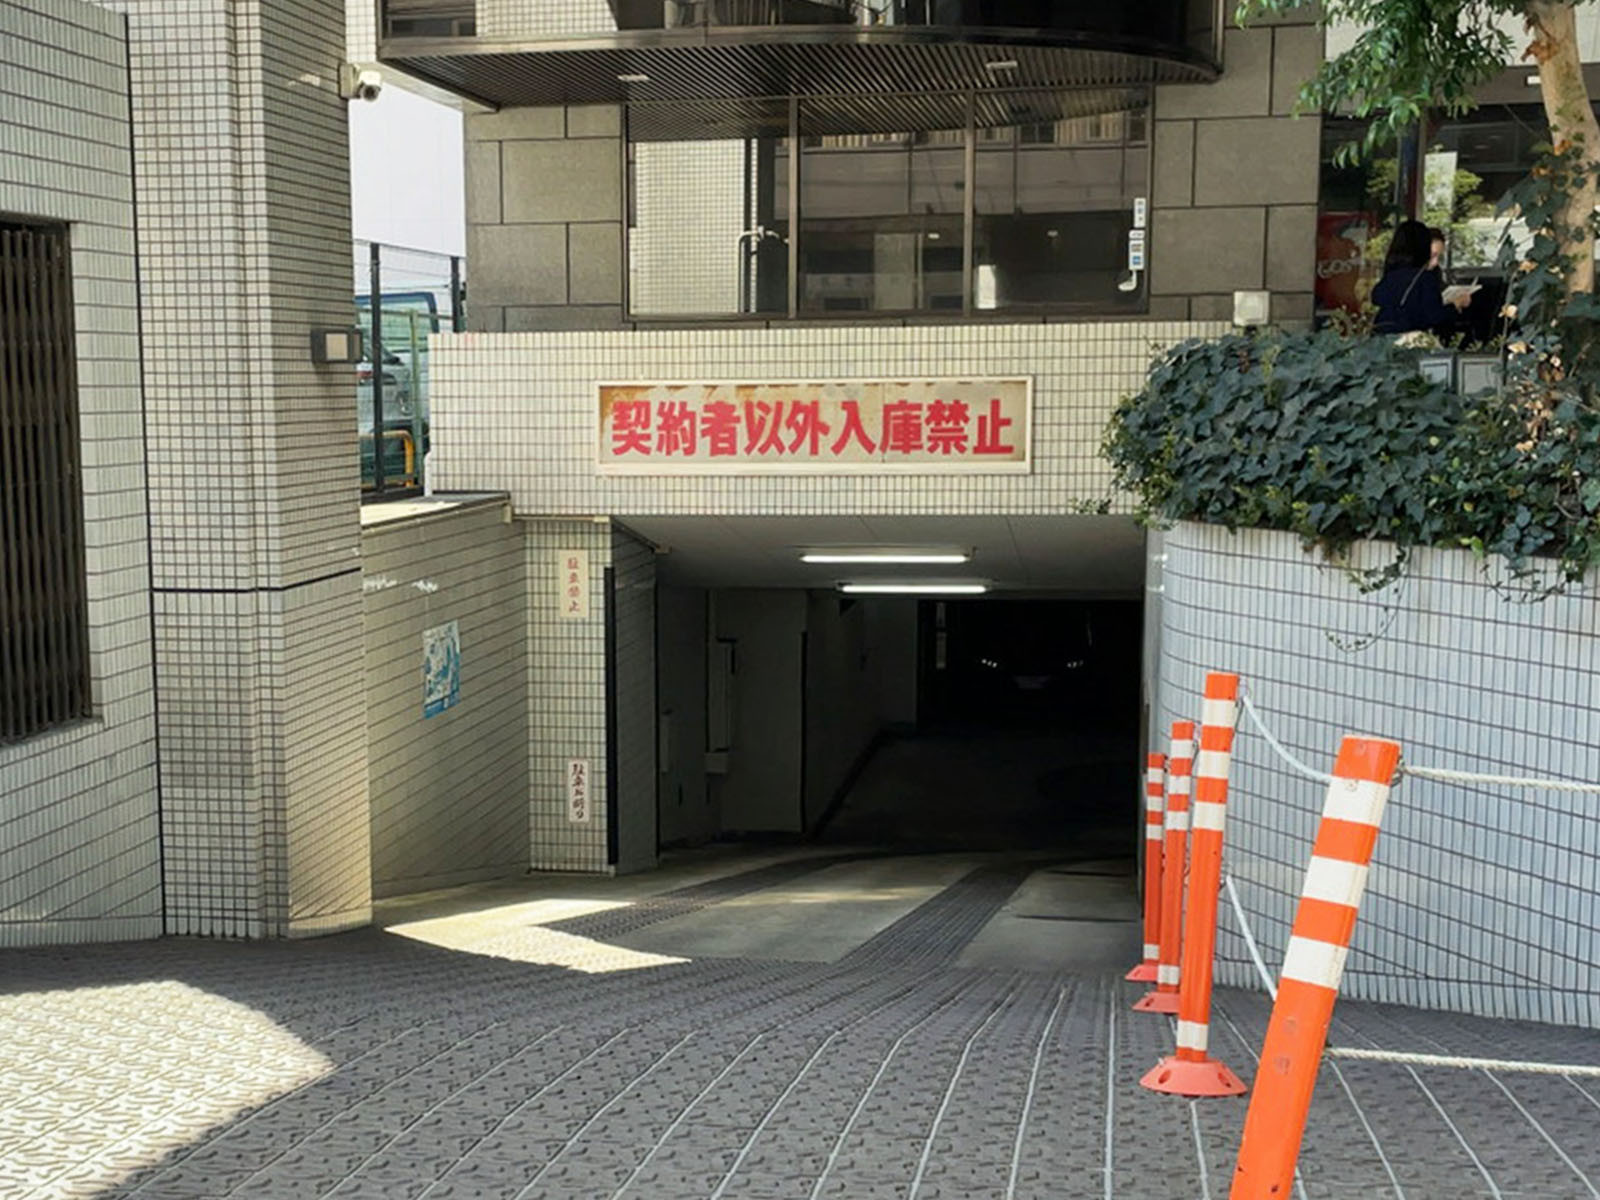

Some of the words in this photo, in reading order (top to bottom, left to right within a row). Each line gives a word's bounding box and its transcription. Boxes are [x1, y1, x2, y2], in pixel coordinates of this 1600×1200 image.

[611, 399, 1014, 457] 契約者以外入庫禁止
